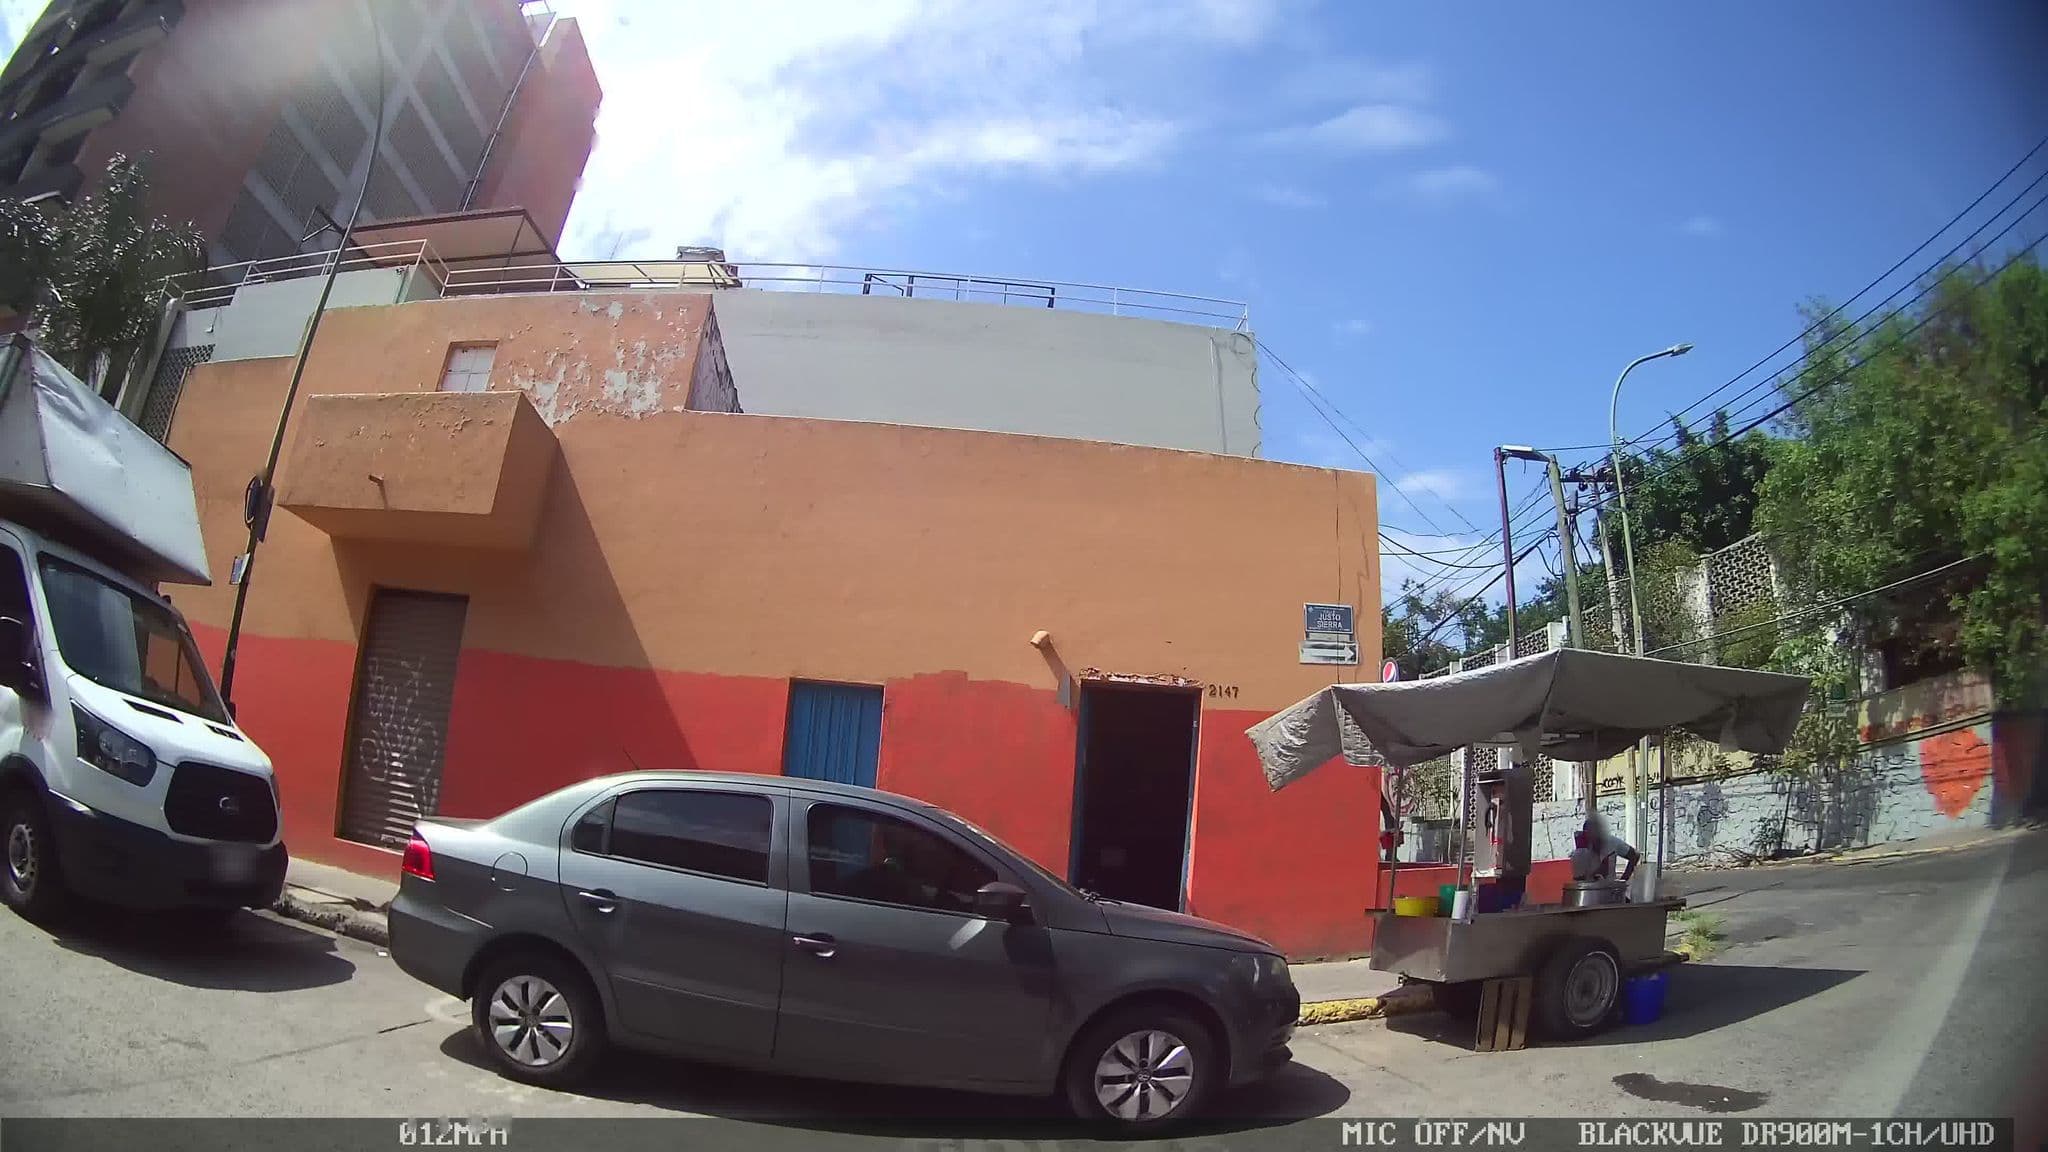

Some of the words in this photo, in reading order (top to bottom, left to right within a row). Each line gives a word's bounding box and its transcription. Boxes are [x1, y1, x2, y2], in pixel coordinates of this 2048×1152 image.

[1319, 613, 1341, 621] JUSTO
[1316, 620, 1343, 629] SIERRA
[1208, 683, 1239, 699] 2147
